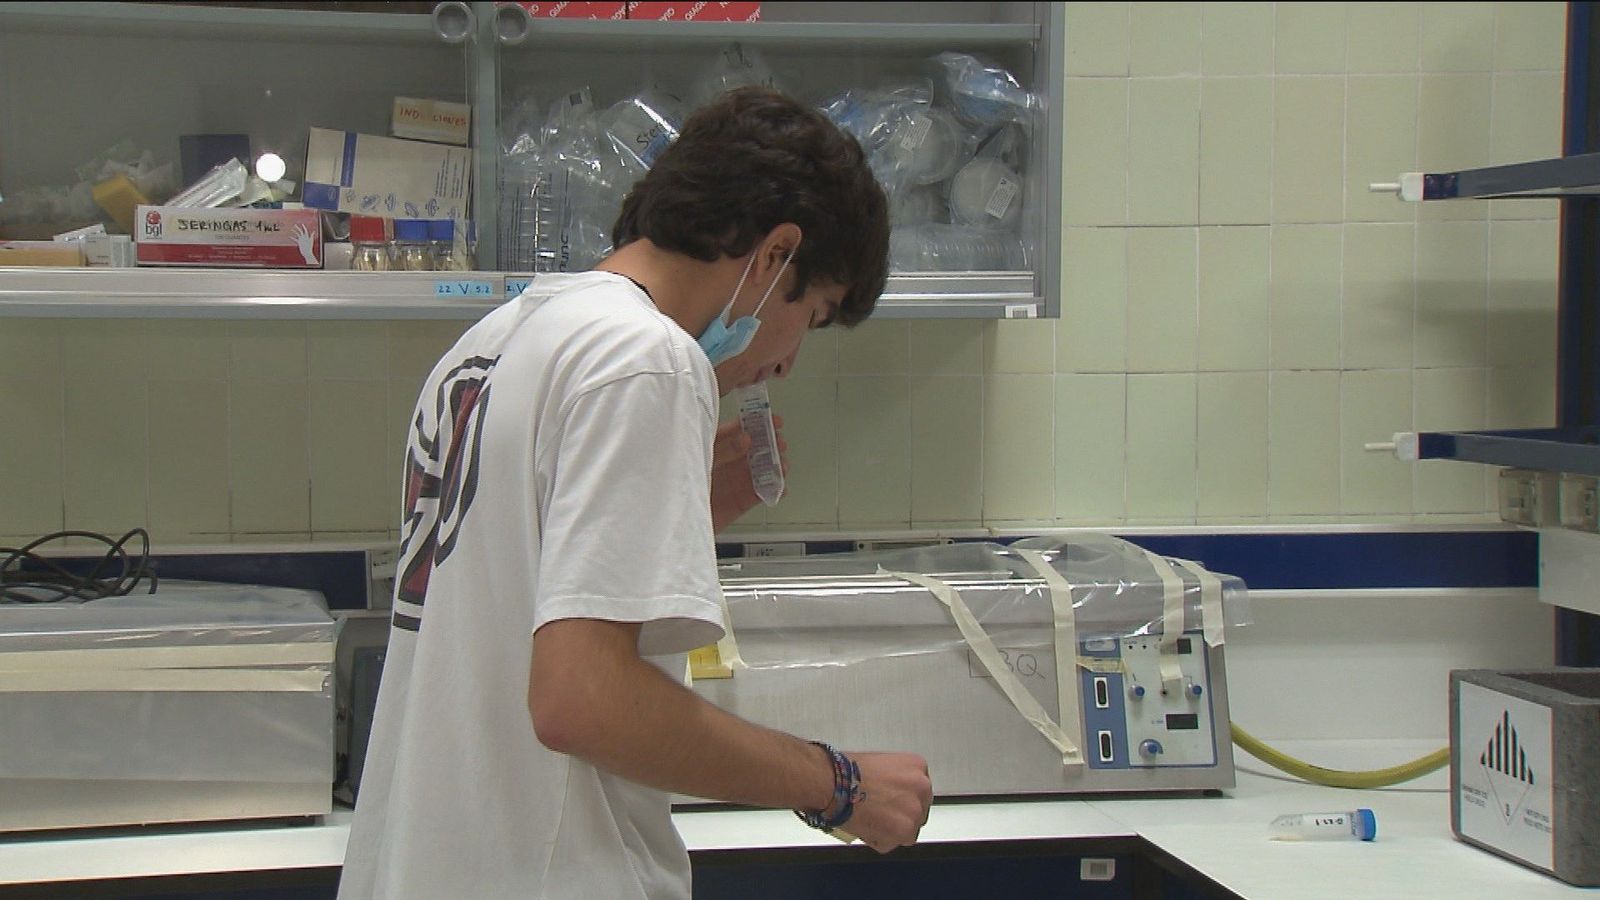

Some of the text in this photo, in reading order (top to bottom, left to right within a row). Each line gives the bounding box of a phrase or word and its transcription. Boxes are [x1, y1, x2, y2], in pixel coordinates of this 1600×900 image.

[145, 221, 162, 237] bgl
[177, 218, 248, 231] SERINGAS
[438, 285, 452, 293] 22
[458, 283, 470, 295] V
